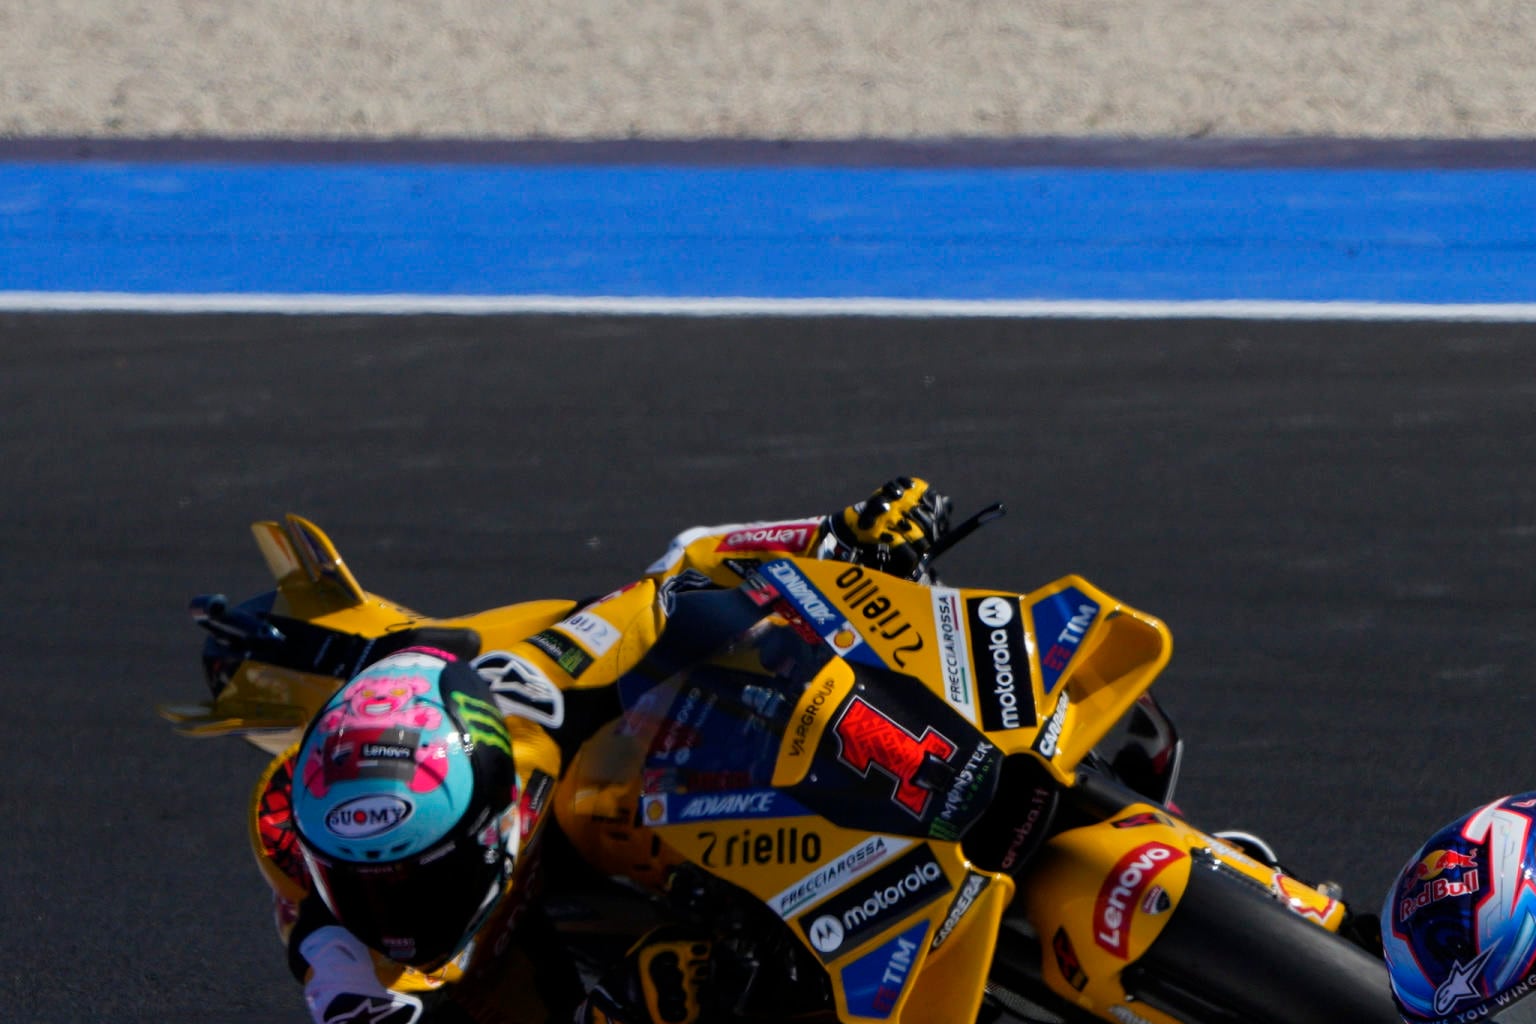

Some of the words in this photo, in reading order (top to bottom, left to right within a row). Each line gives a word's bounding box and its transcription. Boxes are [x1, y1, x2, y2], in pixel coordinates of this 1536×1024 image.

[937, 595, 960, 703] FRECCIAROSSA
[1057, 603, 1098, 645] TIM
[988, 628, 1021, 730] motorola
[361, 742, 411, 759] Lenovo
[833, 694, 959, 823] 1
[679, 790, 777, 819] ADVANCE
[780, 837, 886, 912] FRECCIAROSSA
[842, 860, 941, 931] motorola
[1098, 845, 1172, 949] Lenovo
[1400, 885, 1432, 923] Red
[1432, 867, 1480, 902] Bull
[930, 873, 986, 949] CARRERA
[881, 935, 917, 985] TIM
[1456, 1005, 1489, 1024] YOU
